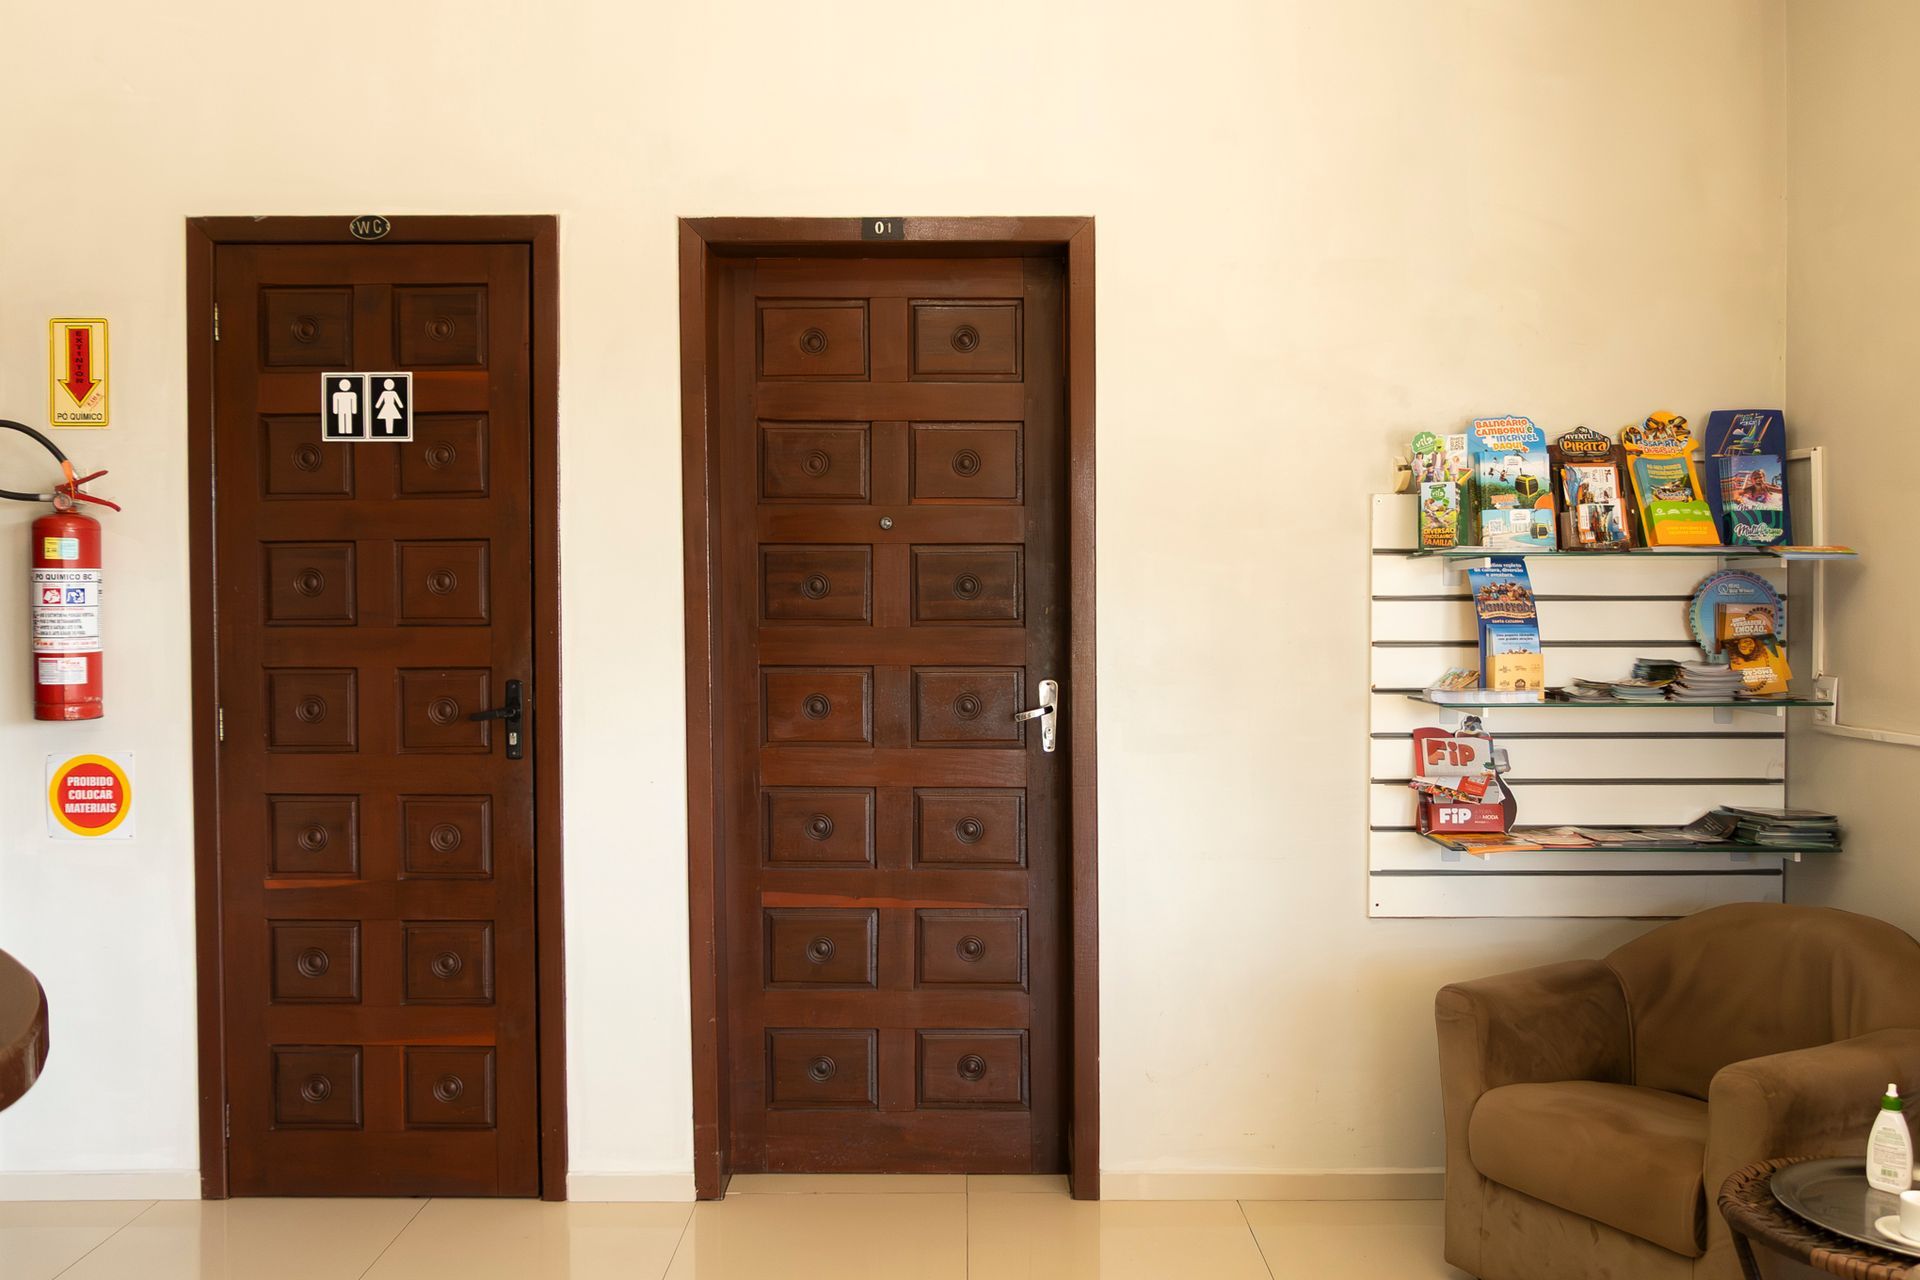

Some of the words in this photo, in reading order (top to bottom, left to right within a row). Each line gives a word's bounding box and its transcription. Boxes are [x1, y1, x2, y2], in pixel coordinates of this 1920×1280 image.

[356, 219, 382, 234] WC
[874, 221, 892, 234] 01
[67, 776, 114, 786] PROIBIDO
[68, 789, 113, 799] COLOCAR
[65, 803, 117, 813] MATERIAIS
